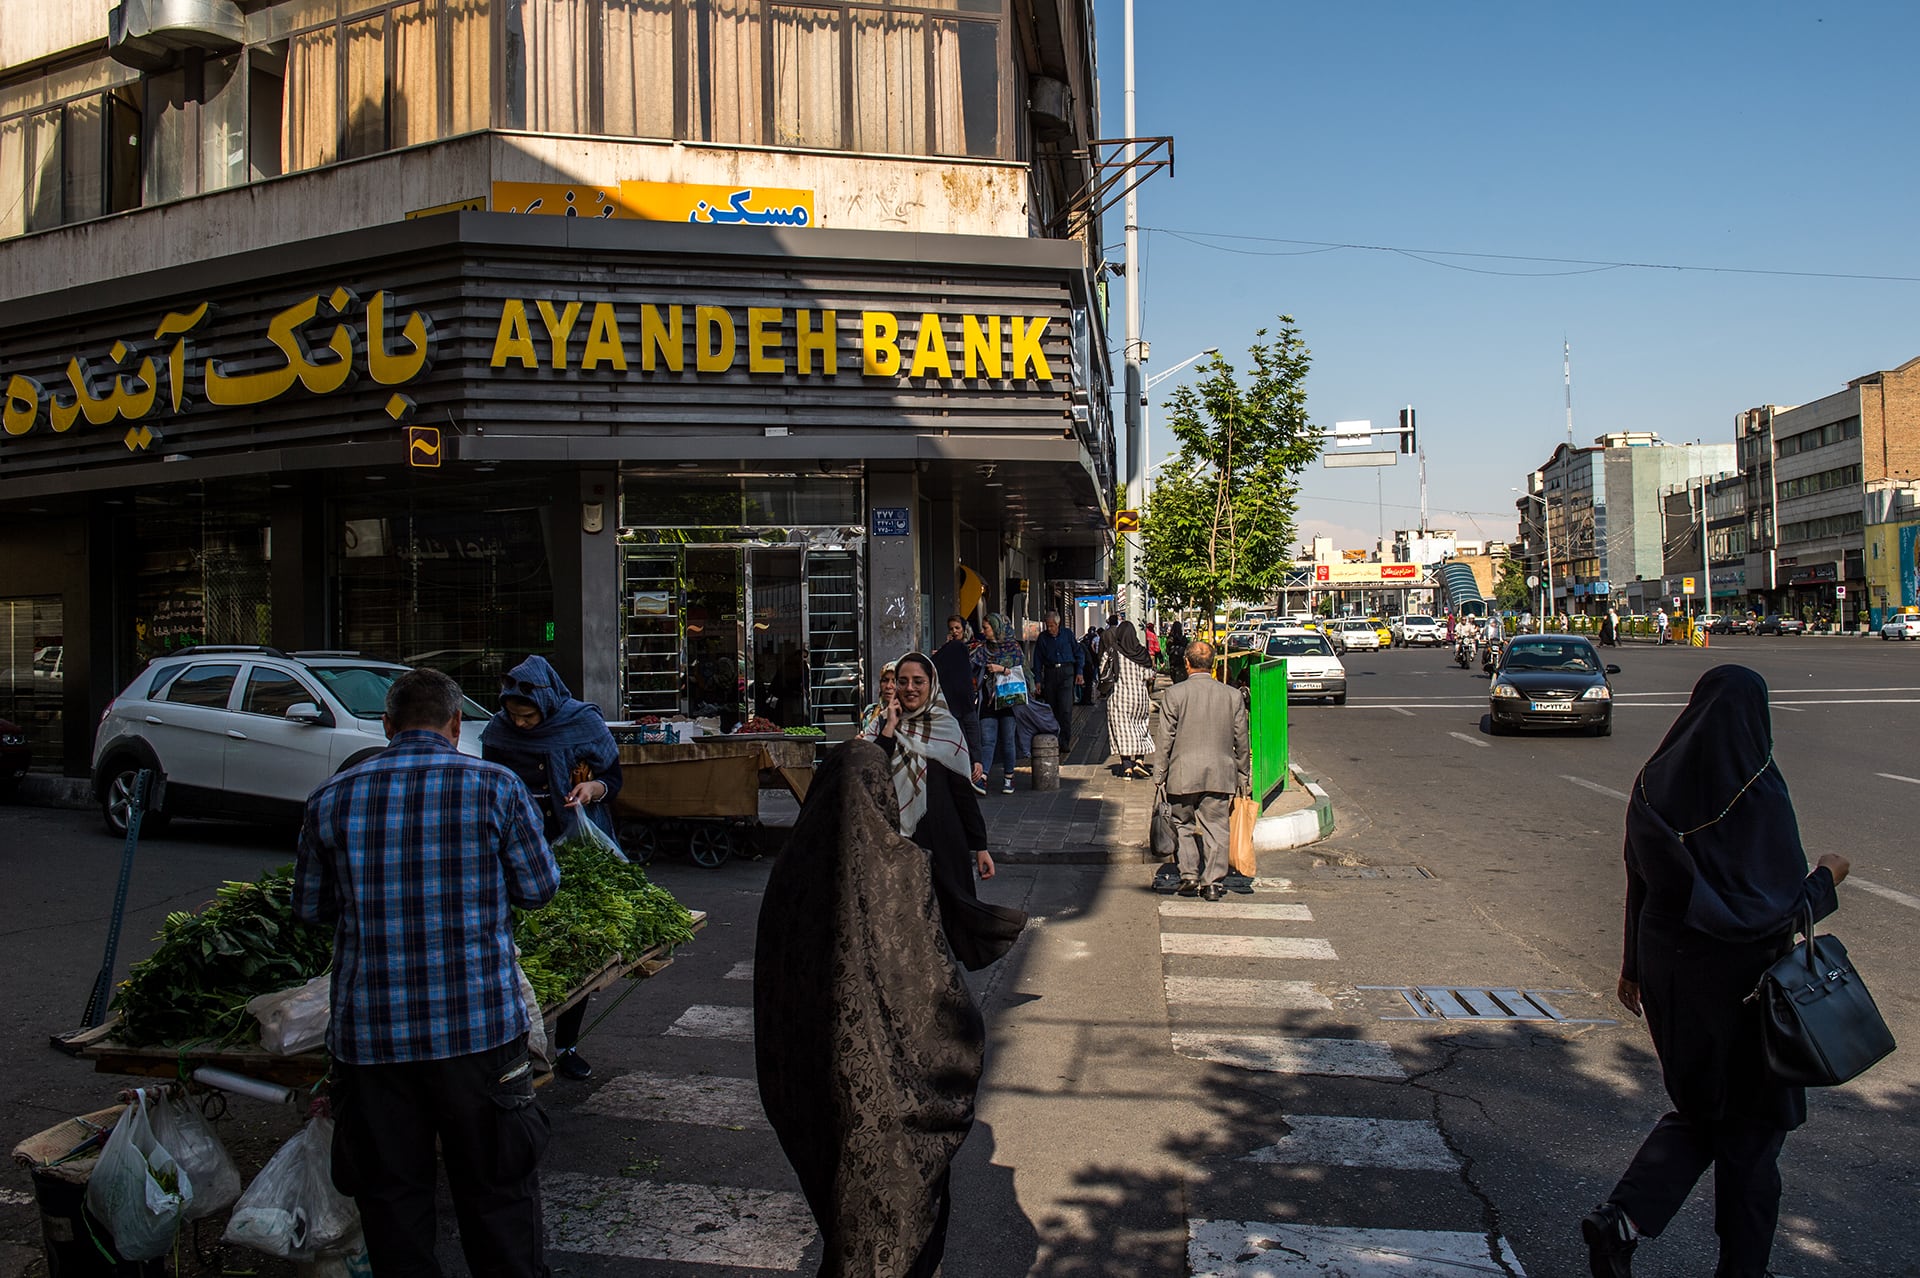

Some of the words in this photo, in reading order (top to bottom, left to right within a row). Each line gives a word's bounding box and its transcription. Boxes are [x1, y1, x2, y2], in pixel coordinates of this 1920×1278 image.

[2, 301, 214, 452] آینده
[204, 286, 432, 422] بانک
[490, 299, 838, 377] AYANDEH
[861, 311, 1054, 381] BANK
